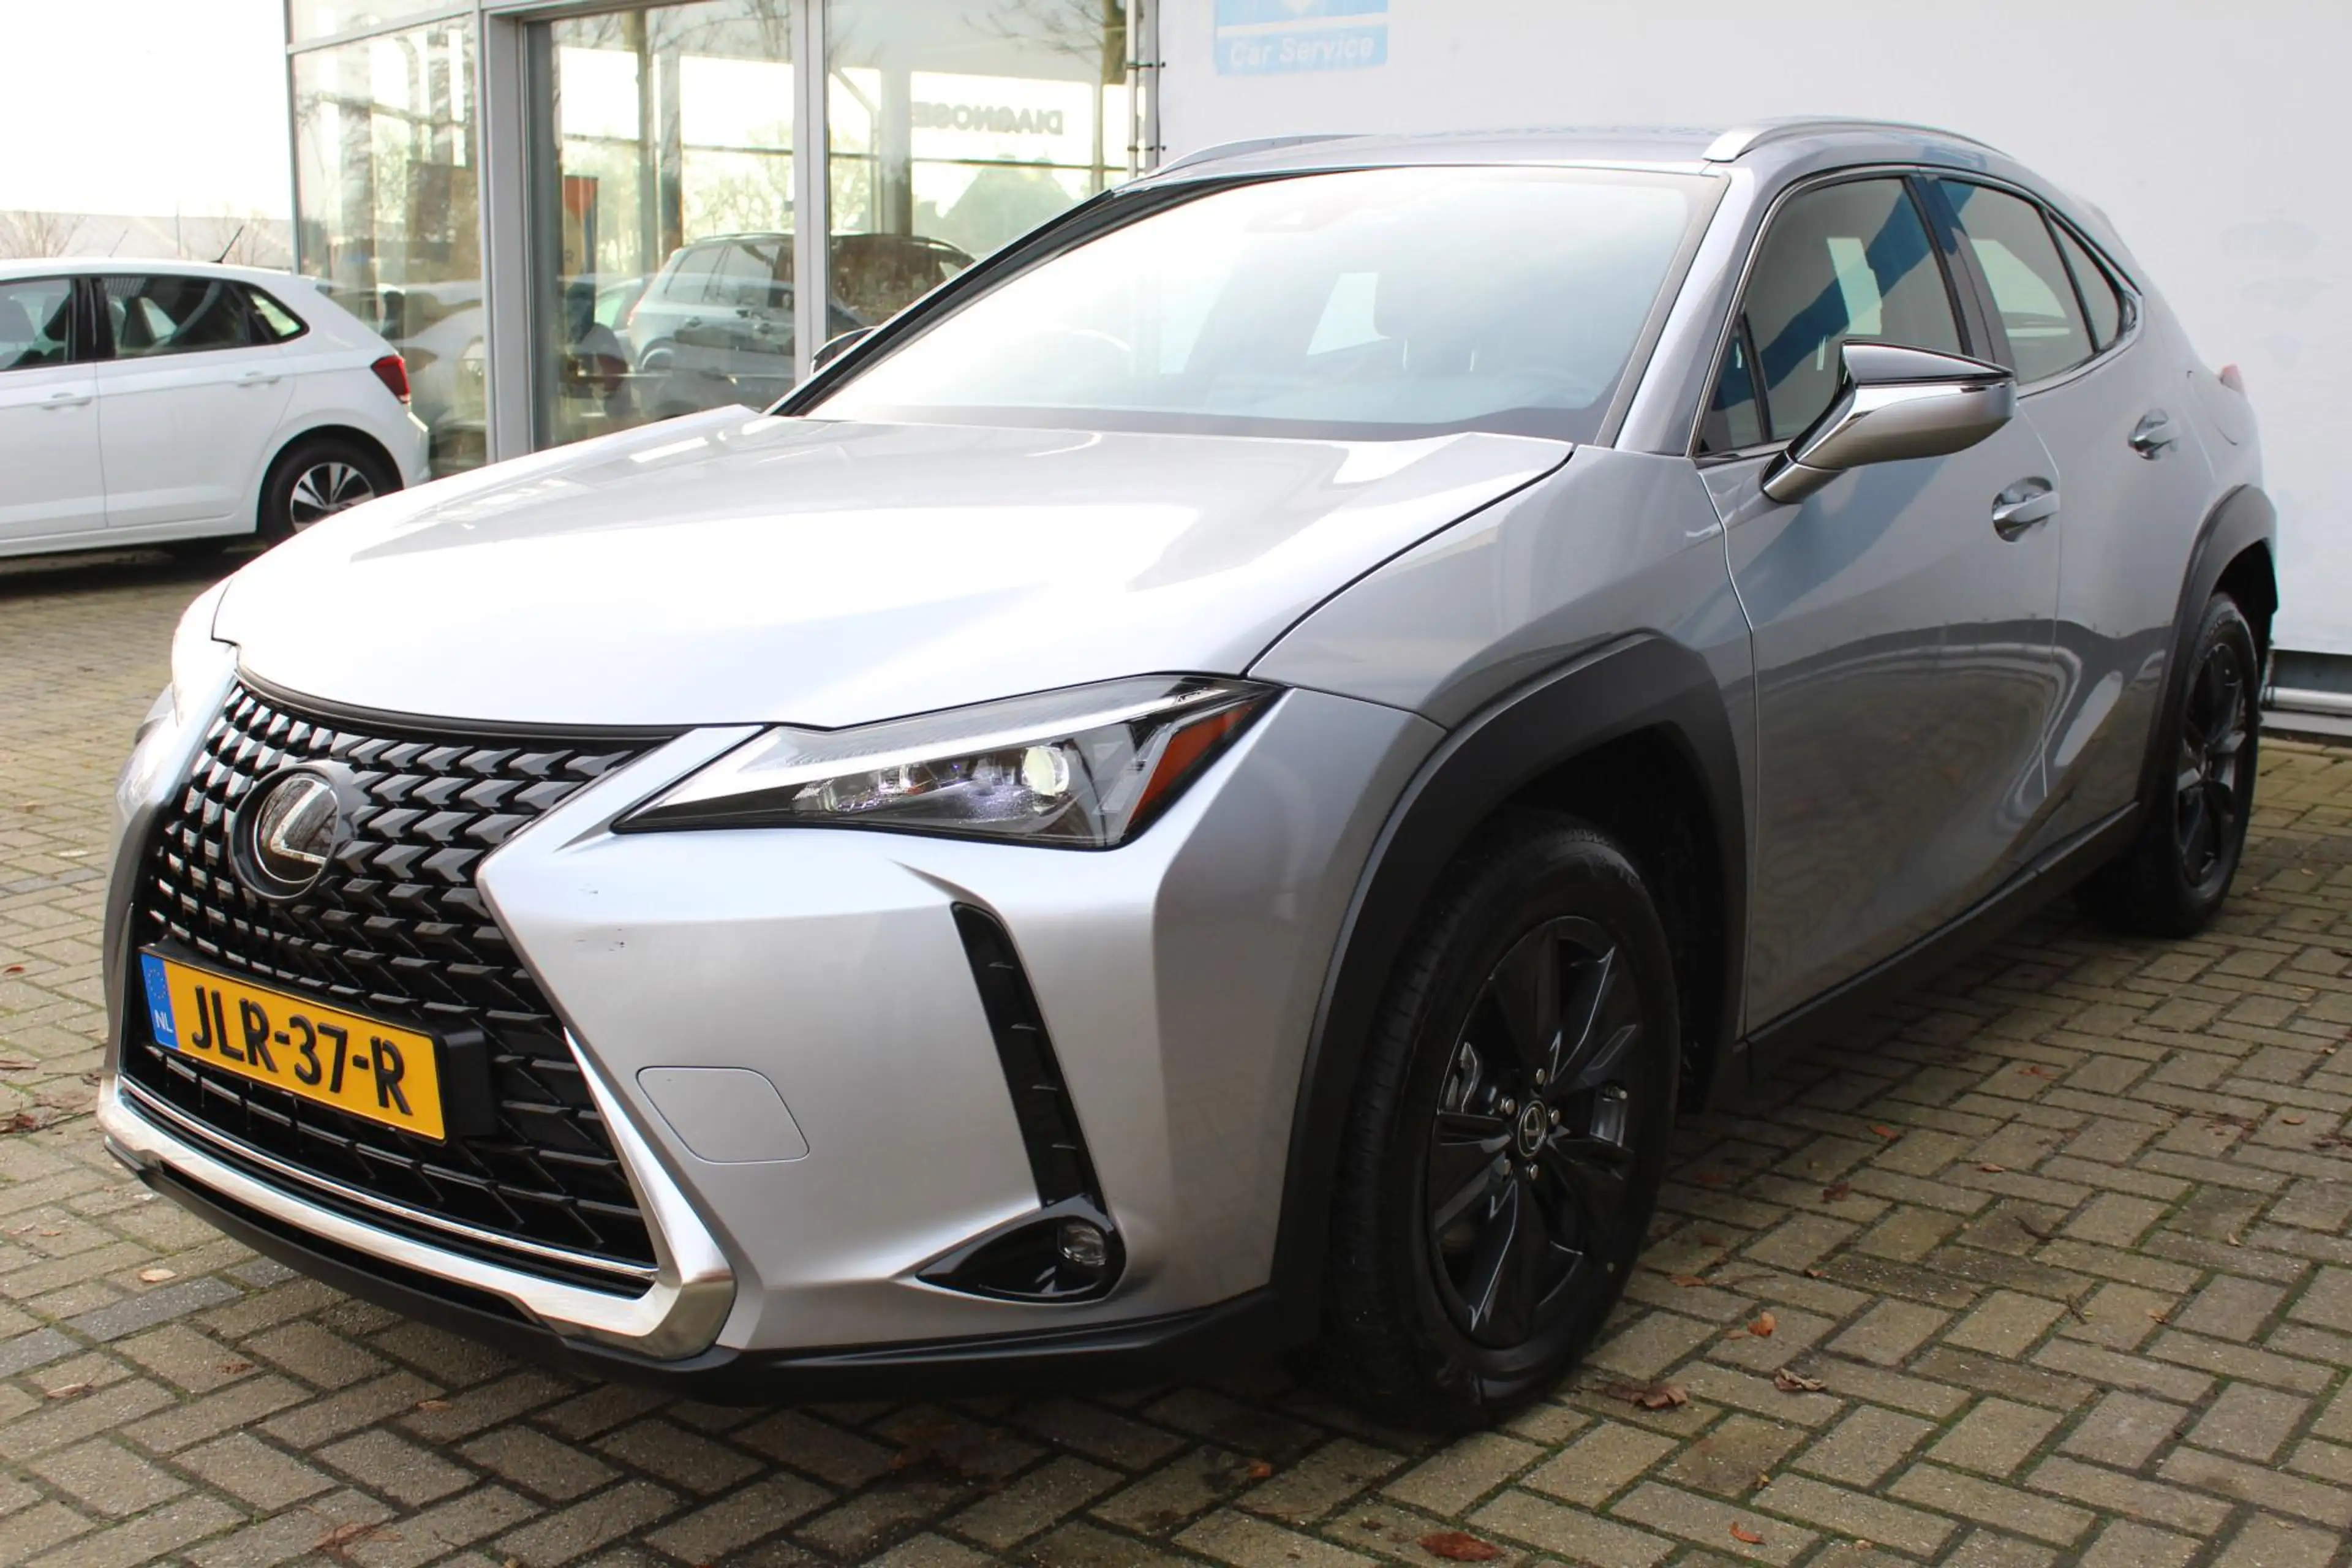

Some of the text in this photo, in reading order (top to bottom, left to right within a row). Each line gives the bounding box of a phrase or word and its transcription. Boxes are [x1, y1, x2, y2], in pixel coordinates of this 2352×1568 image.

[1231, 34, 1374, 66] Car Service
[154, 1009, 174, 1033] NL
[192, 985, 413, 1116] JLR-37-R
